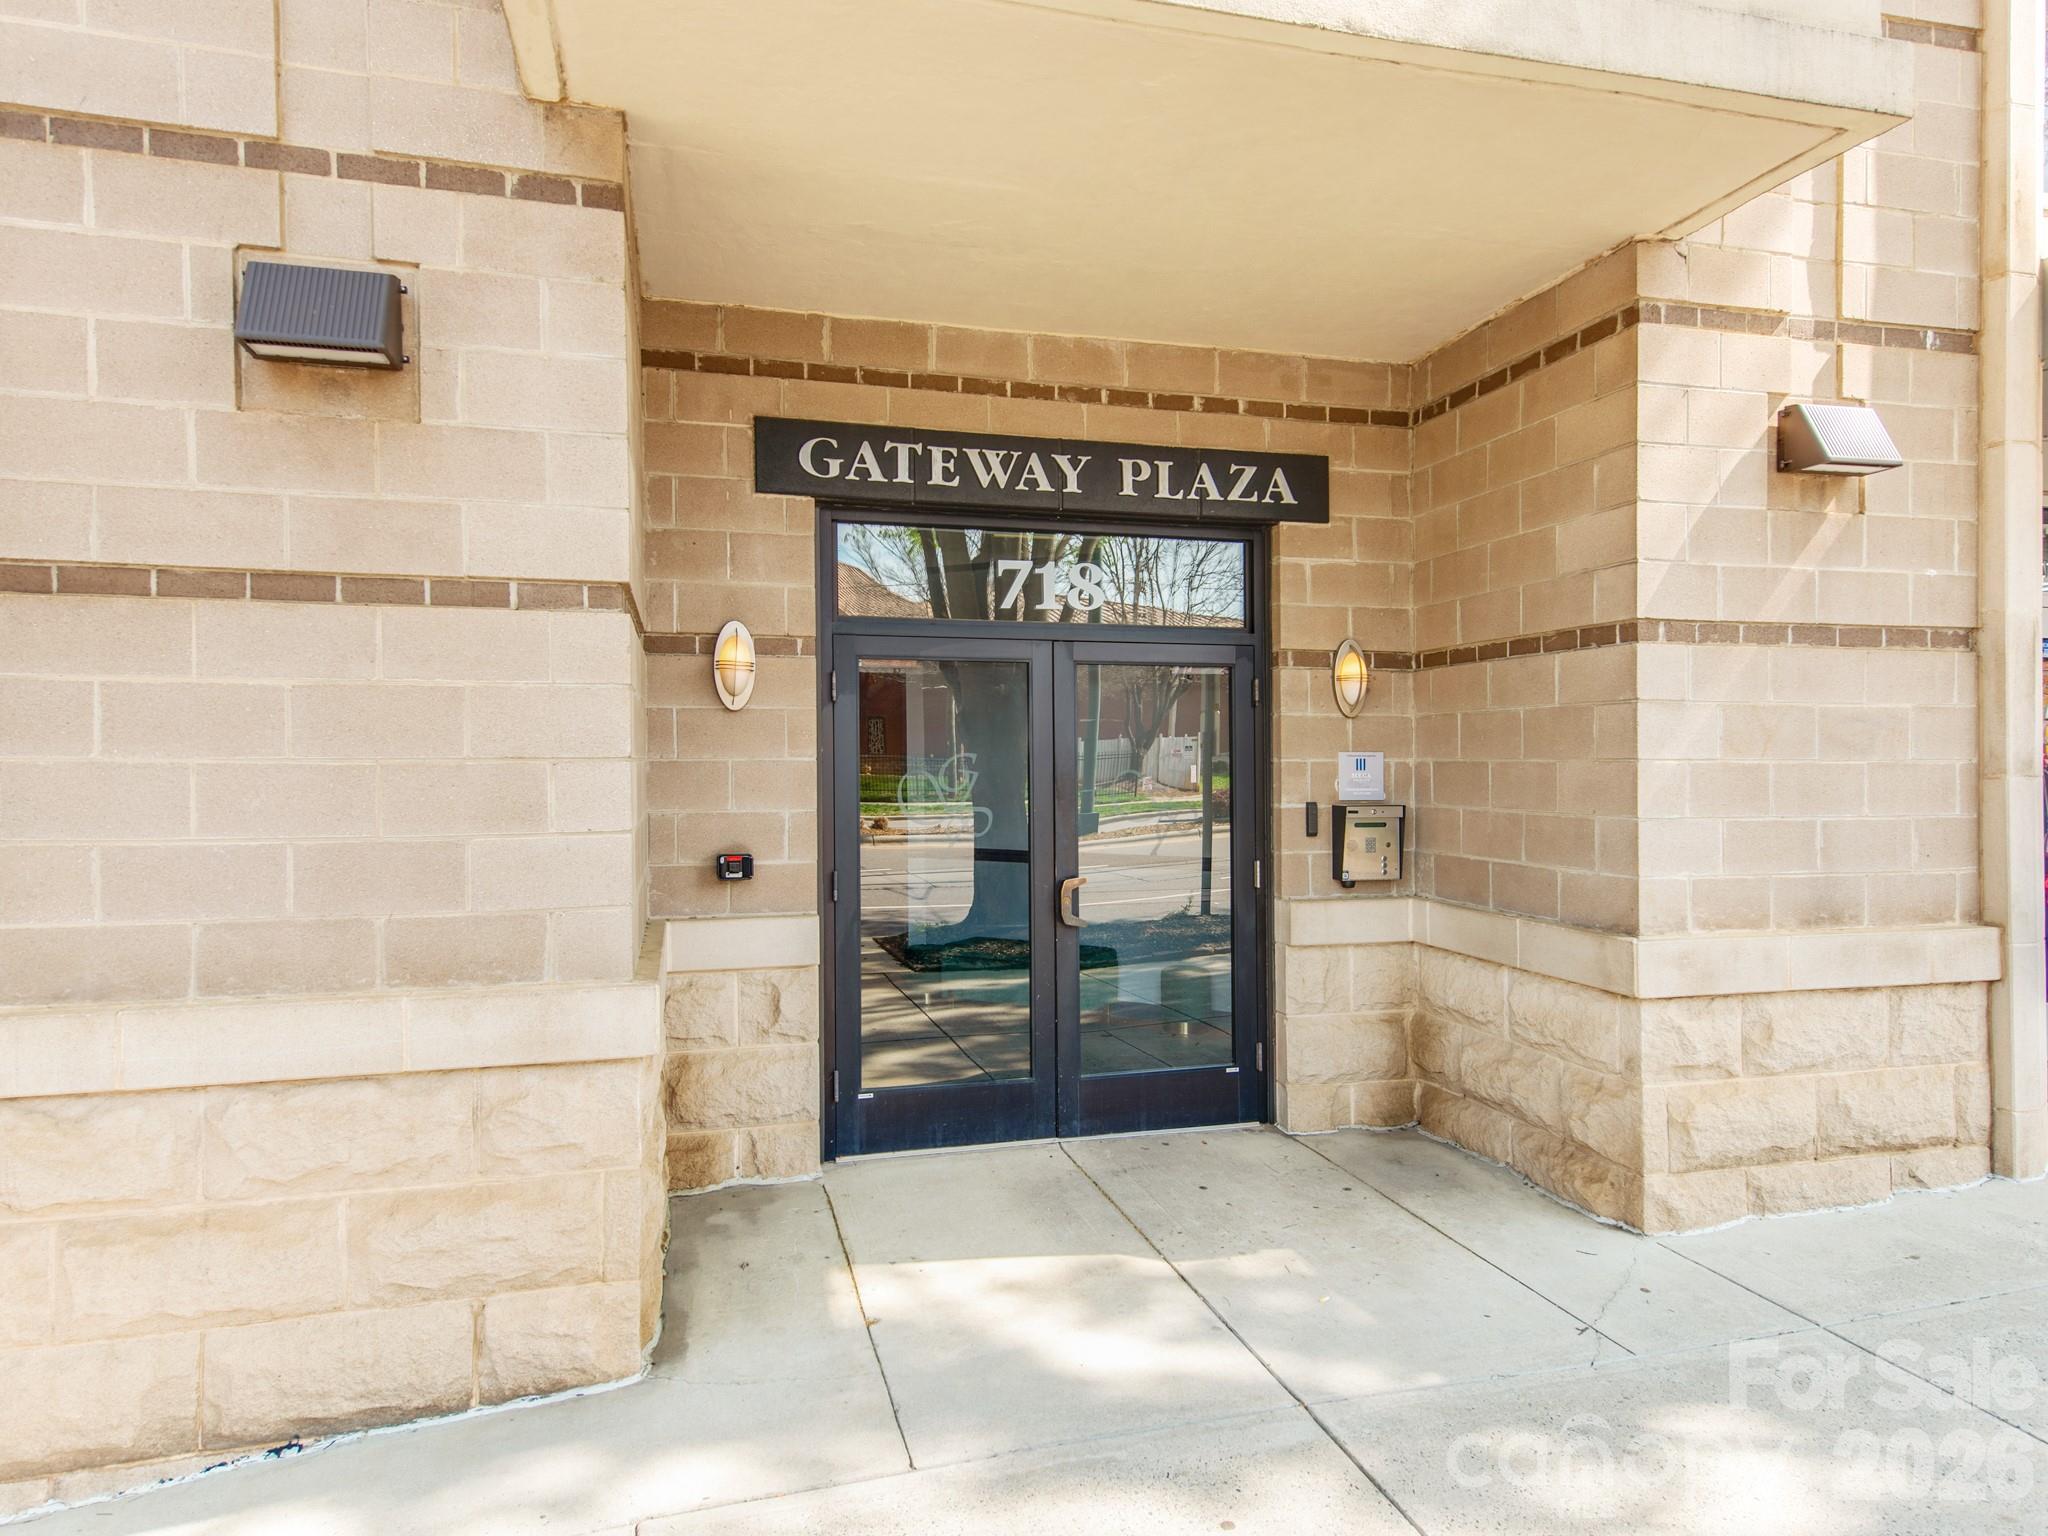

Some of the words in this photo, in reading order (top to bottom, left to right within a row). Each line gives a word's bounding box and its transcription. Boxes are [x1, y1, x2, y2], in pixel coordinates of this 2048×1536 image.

[798, 436, 1092, 495] GATEWAY
[1117, 457, 1299, 505] PLAZA
[998, 559, 1104, 612] 718
